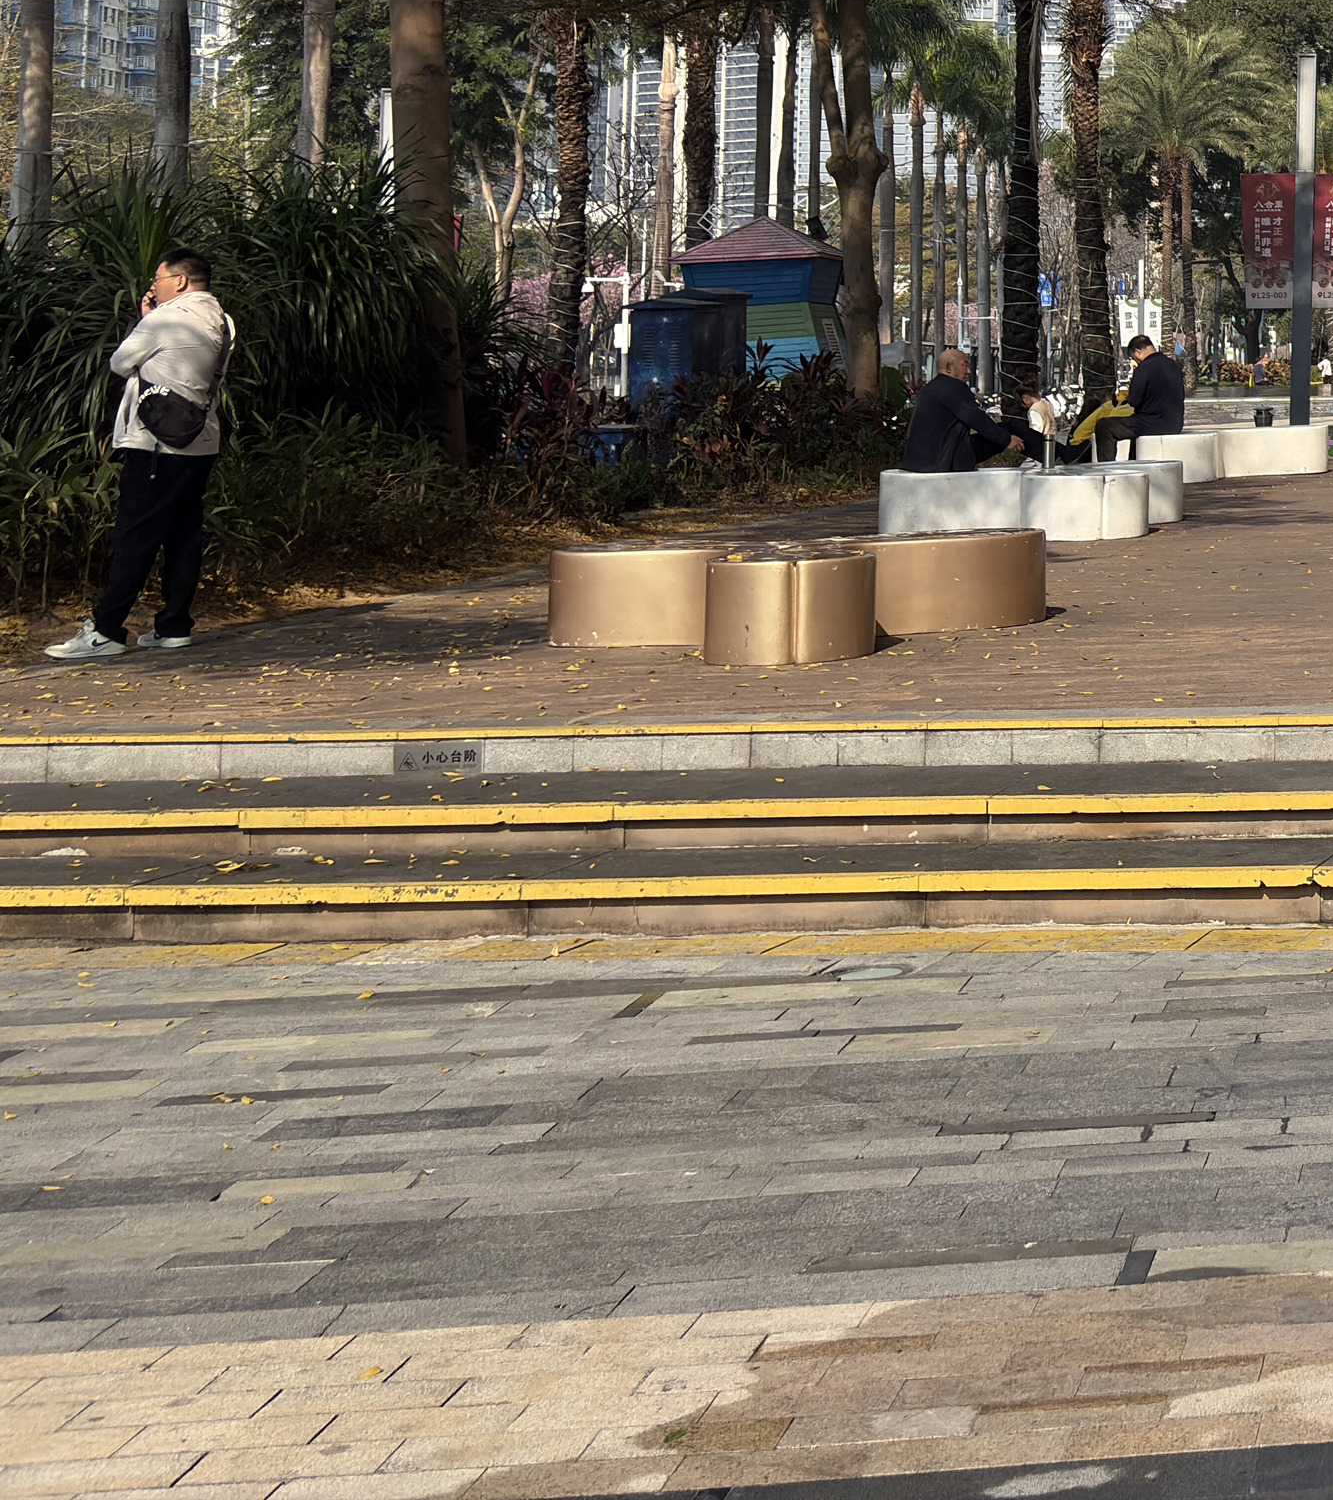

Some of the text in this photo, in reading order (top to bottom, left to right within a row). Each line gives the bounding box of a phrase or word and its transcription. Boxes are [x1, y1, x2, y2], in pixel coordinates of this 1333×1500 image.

[1253, 200, 1284, 209] 八合里
[1272, 216, 1283, 247] 才正宗
[422, 749, 476, 764] 小心台阶
